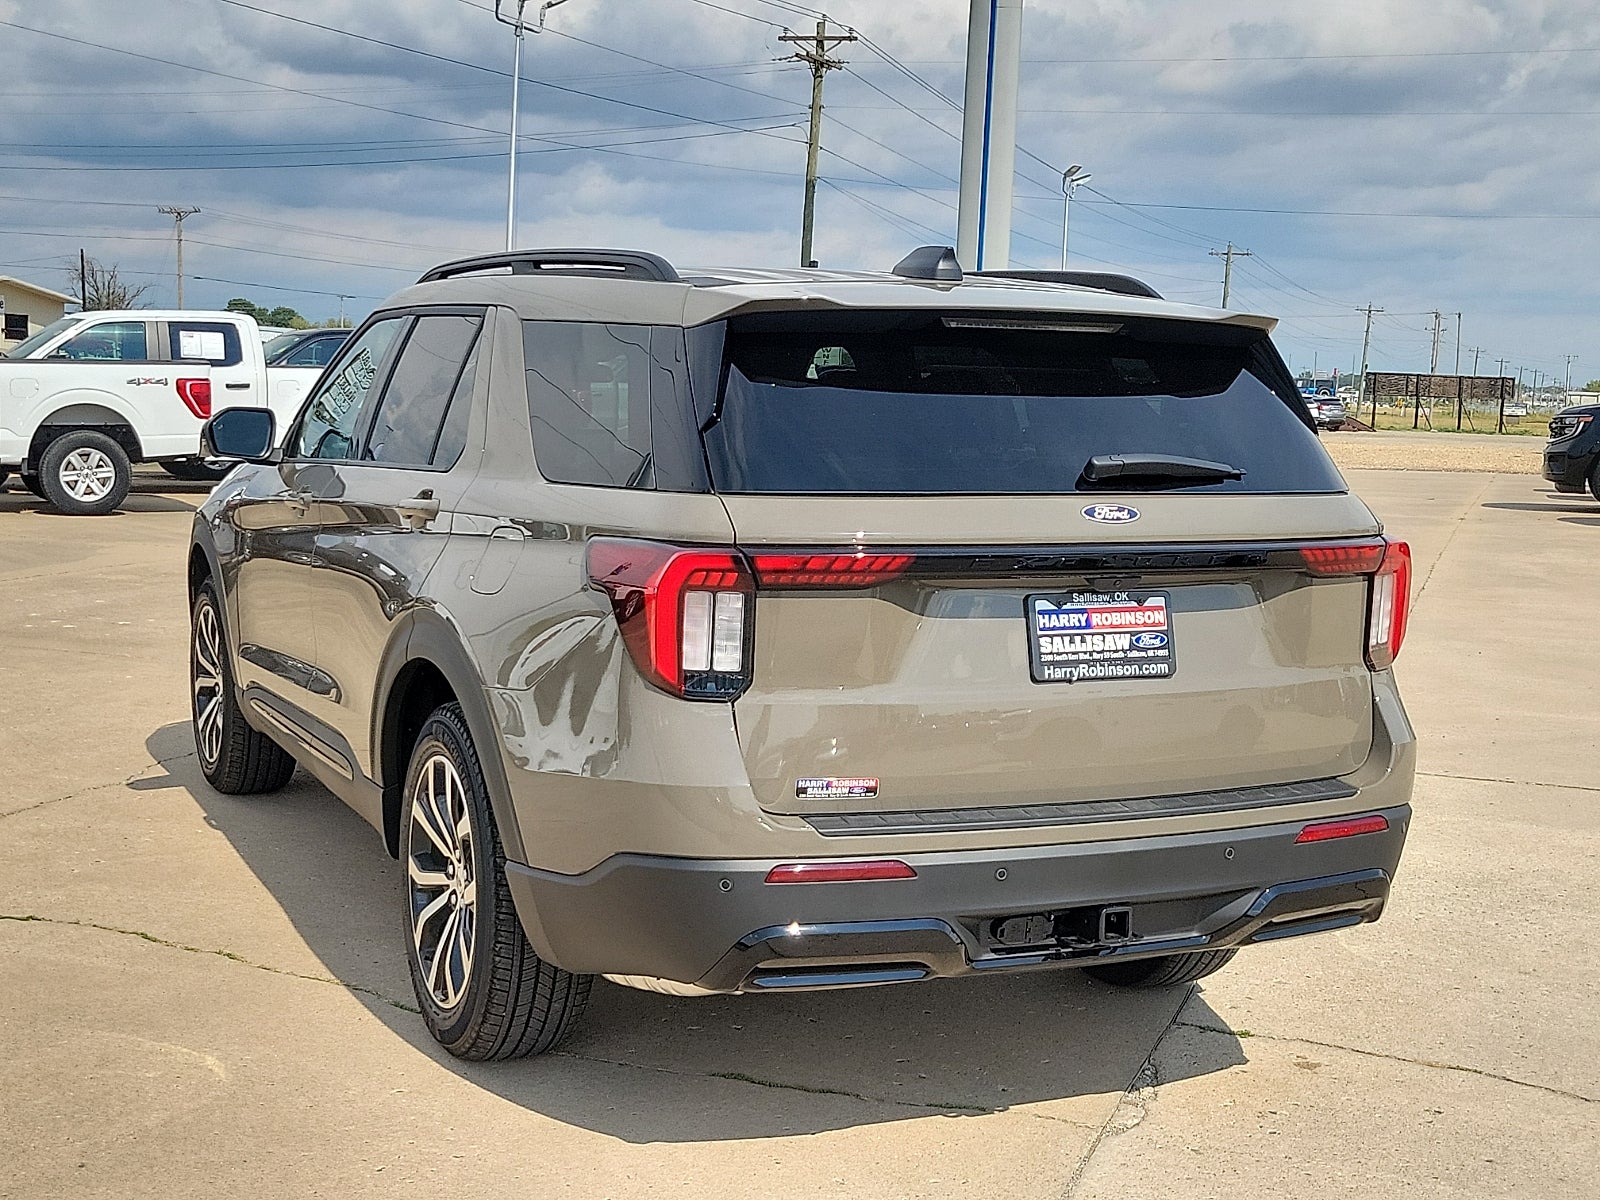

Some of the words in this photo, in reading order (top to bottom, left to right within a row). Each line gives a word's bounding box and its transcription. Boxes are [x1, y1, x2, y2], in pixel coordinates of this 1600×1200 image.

[1091, 504, 1133, 520] Ford
[1072, 593, 1112, 603] Sallisaw,
[1115, 592, 1129, 601] OK
[1038, 613, 1088, 628] HARRY
[1092, 610, 1164, 627] ROBINSON
[1039, 634, 1131, 653] SALLISAW
[1137, 634, 1163, 646] Ford
[1044, 663, 1169, 680] HarryRobinson.com
[798, 779, 828, 788] HARRY
[832, 779, 876, 787] ROBINSON
